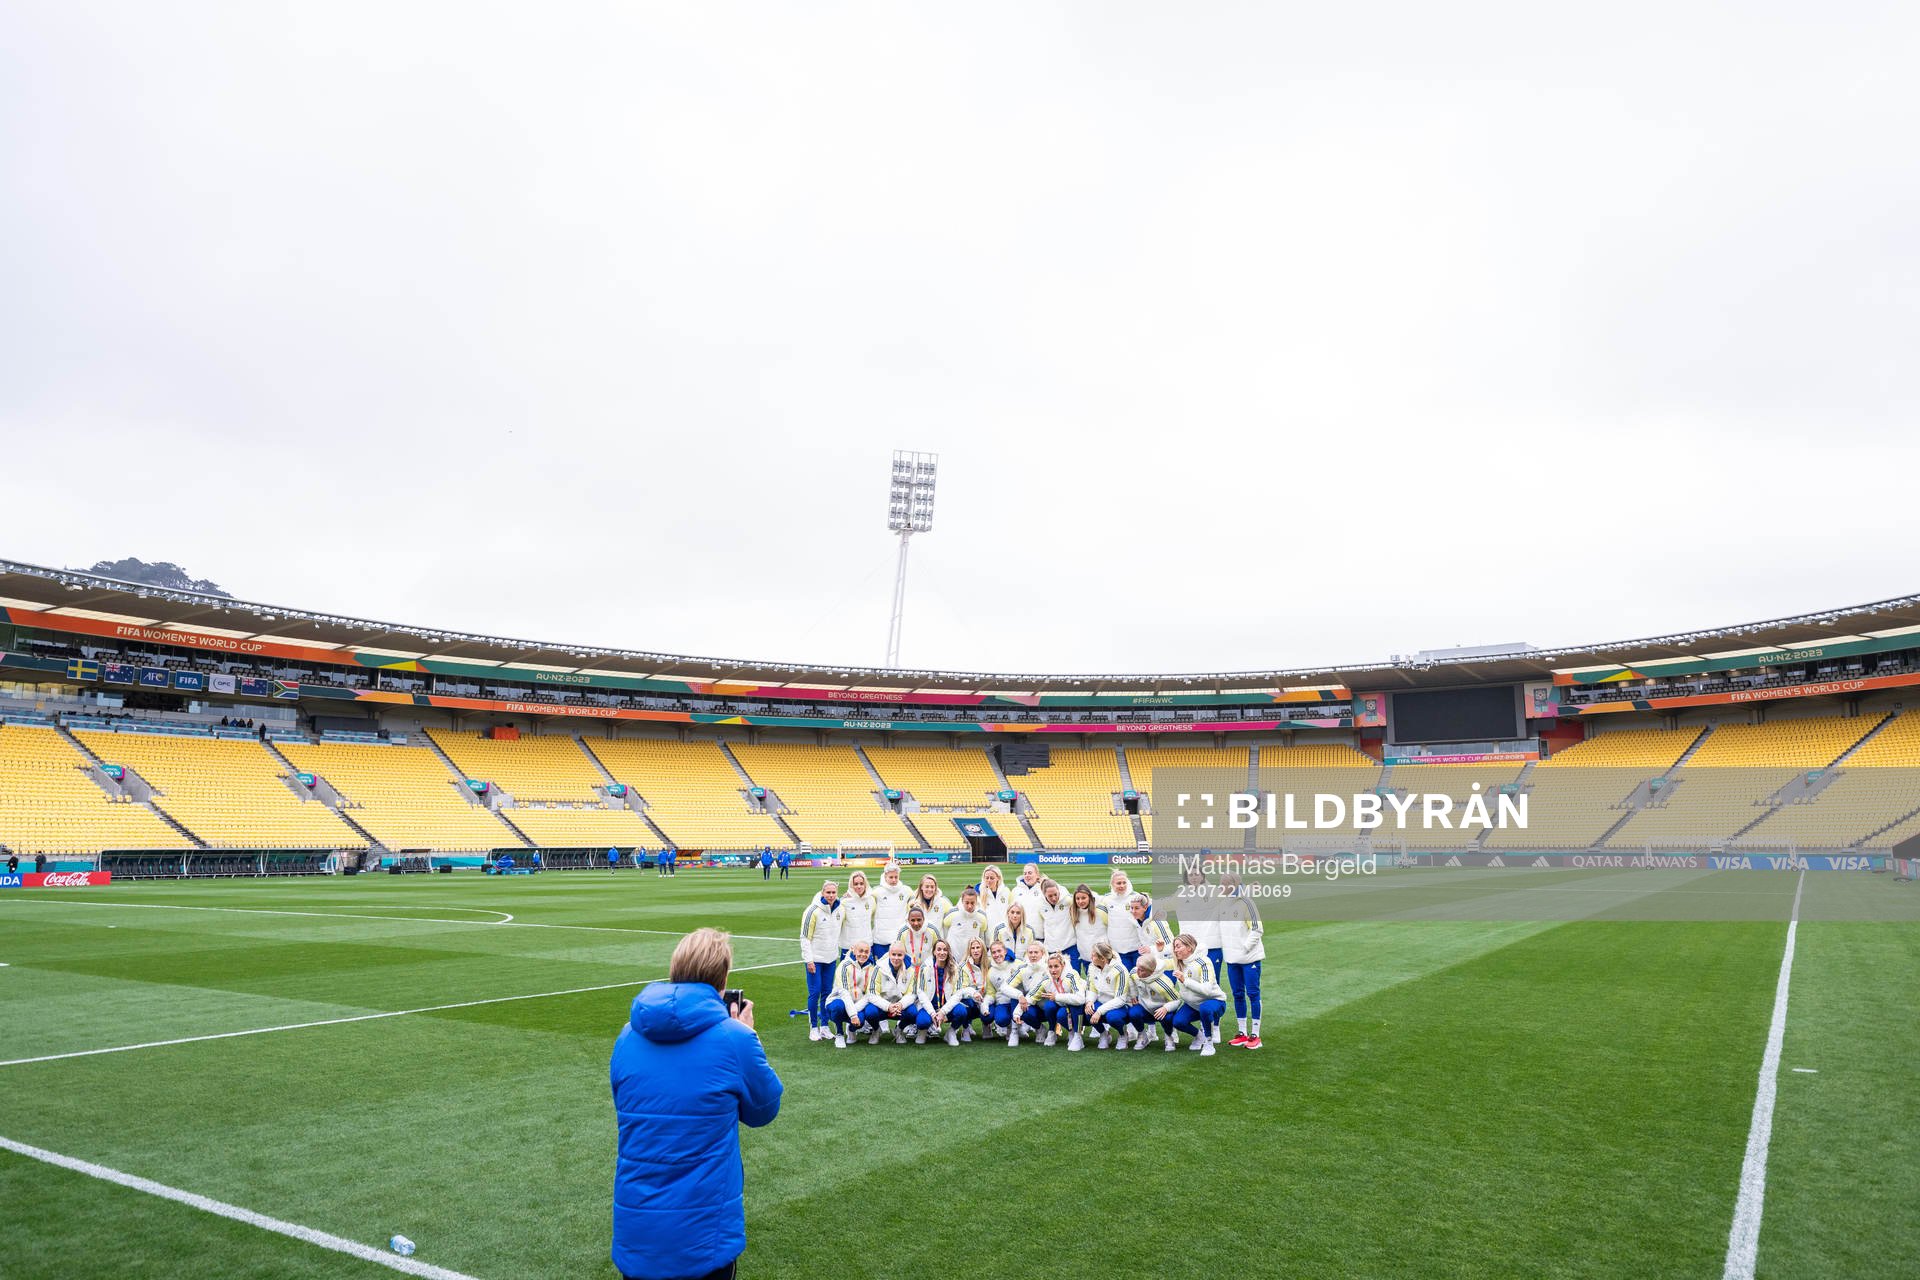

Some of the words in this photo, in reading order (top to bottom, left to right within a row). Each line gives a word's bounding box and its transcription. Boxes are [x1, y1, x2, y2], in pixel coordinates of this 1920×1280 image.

[116, 626, 140, 637] FIFA
[143, 629, 197, 644] WOMEN'S
[199, 637, 237, 649] WORLD
[240, 642, 262, 652] CUP
[179, 676, 198, 685] FIFA
[828, 691, 858, 699] BEYOND
[1730, 693, 1751, 701] FIFA
[1753, 687, 1801, 699] WOMEN'S
[1803, 683, 1840, 694] WORLD
[1843, 681, 1865, 690] CUP
[506, 703, 525, 711] FIFA
[525, 704, 566, 714] WOMEN'S
[567, 707, 598, 716] WORLD
[600, 709, 618, 717] CUP
[1039, 855, 1086, 865] Booking.com
[1112, 855, 1148, 864] Globant
[1572, 855, 1623, 868] QATAR
[1630, 856, 1698, 868] AIRWAYS
[1711, 857, 1752, 870] VISA
[1766, 857, 1810, 870] VISA
[1825, 857, 1871, 870] VISA
[43, 872, 90, 887] Coca-Cola
